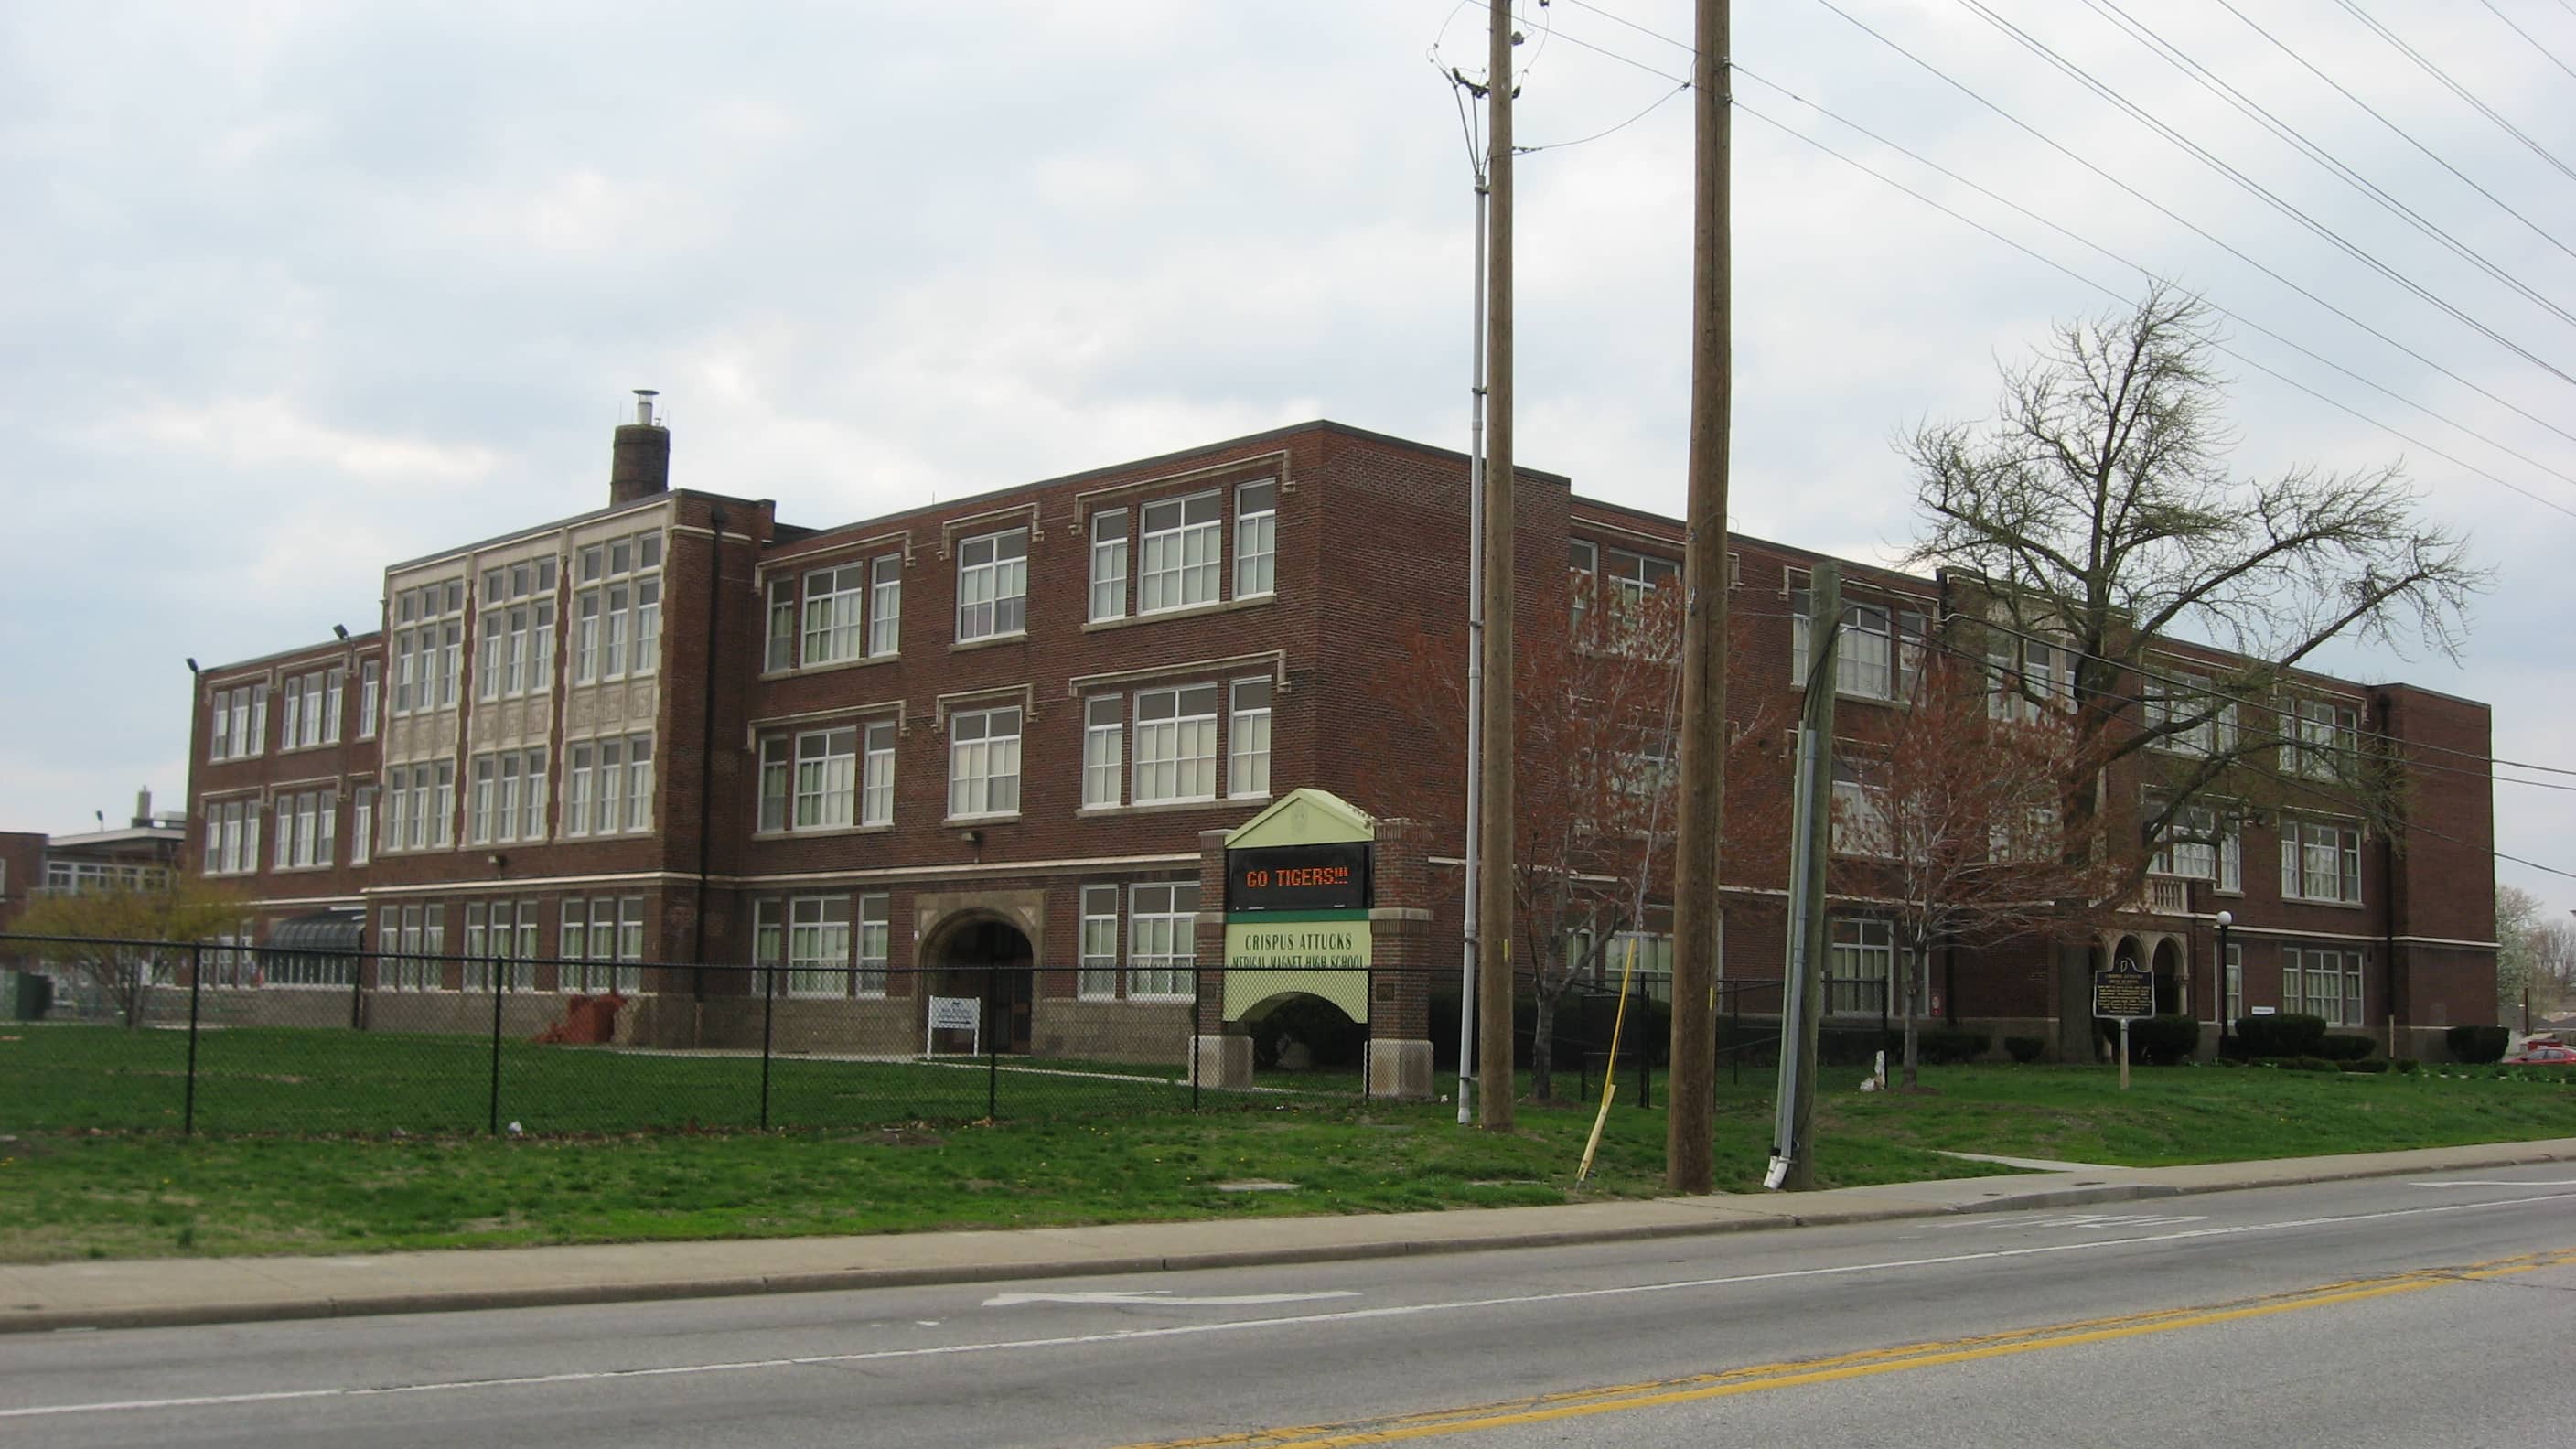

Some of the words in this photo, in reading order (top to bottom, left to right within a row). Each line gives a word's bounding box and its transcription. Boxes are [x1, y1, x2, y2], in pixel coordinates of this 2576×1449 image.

[1246, 871, 1268, 887] GO
[1276, 866, 1347, 886] TIGERS!!!
[1245, 934, 1293, 950] CRISPUS
[1300, 933, 1352, 950] ATTUCKS
[1305, 954, 1326, 968] HIGH
[1330, 954, 1363, 968] SCHOOL
